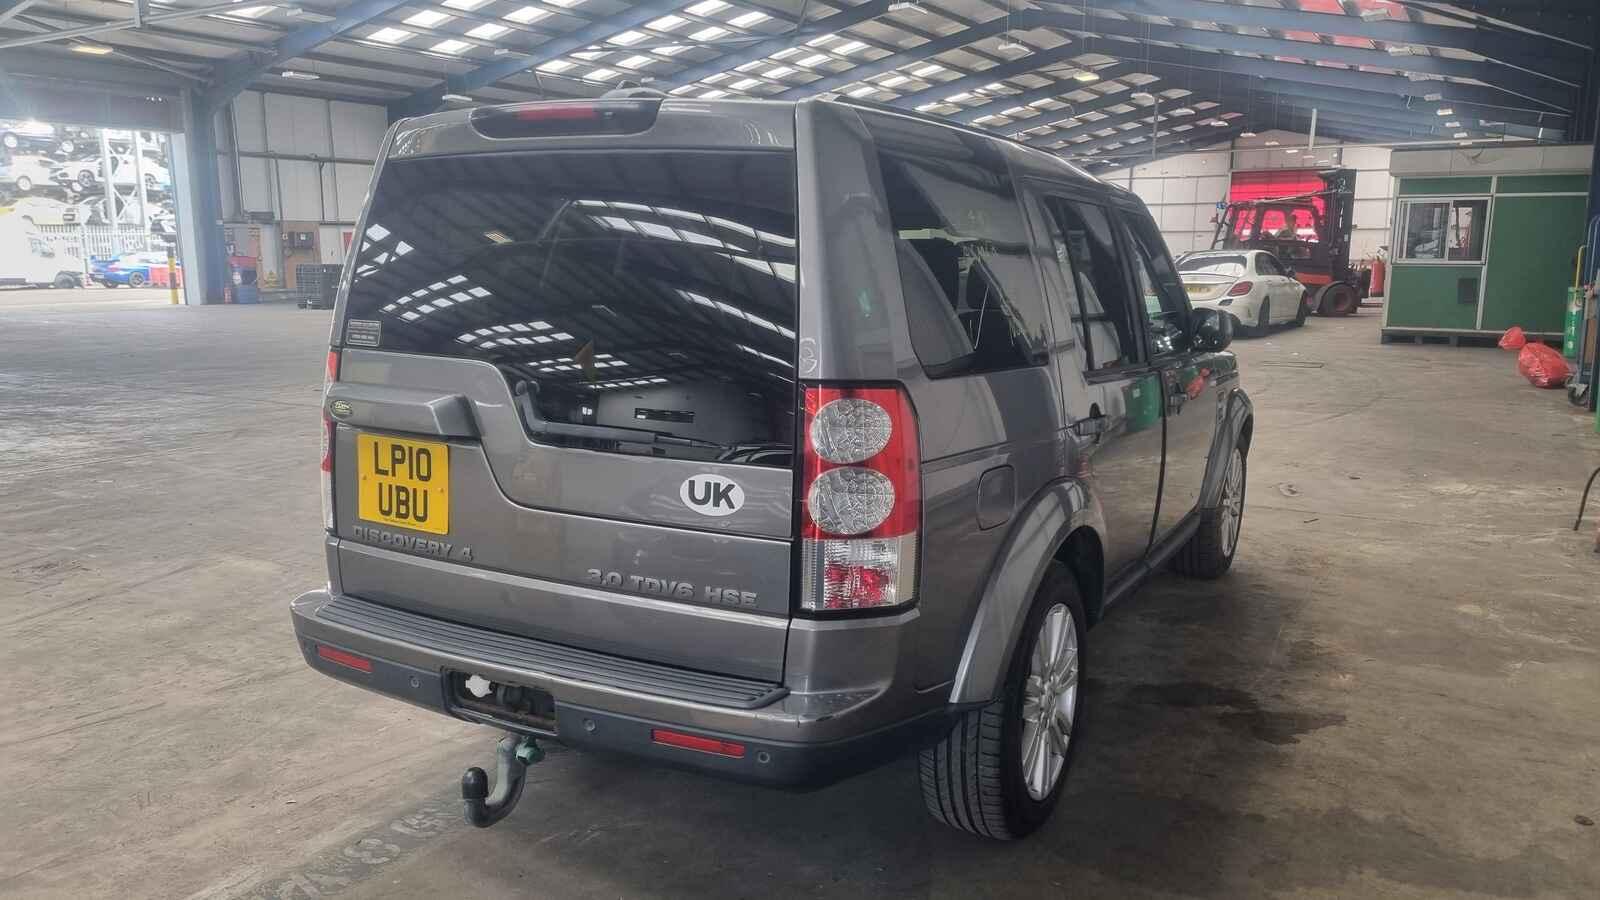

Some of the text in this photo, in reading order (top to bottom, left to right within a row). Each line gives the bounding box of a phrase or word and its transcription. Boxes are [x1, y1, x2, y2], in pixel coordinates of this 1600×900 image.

[374, 441, 432, 482] LP10
[378, 482, 428, 522] UBU
[688, 479, 736, 510] UK
[353, 526, 474, 561] DISCOVERY 4
[587, 567, 758, 608] 3.0 TDV6 HSE
